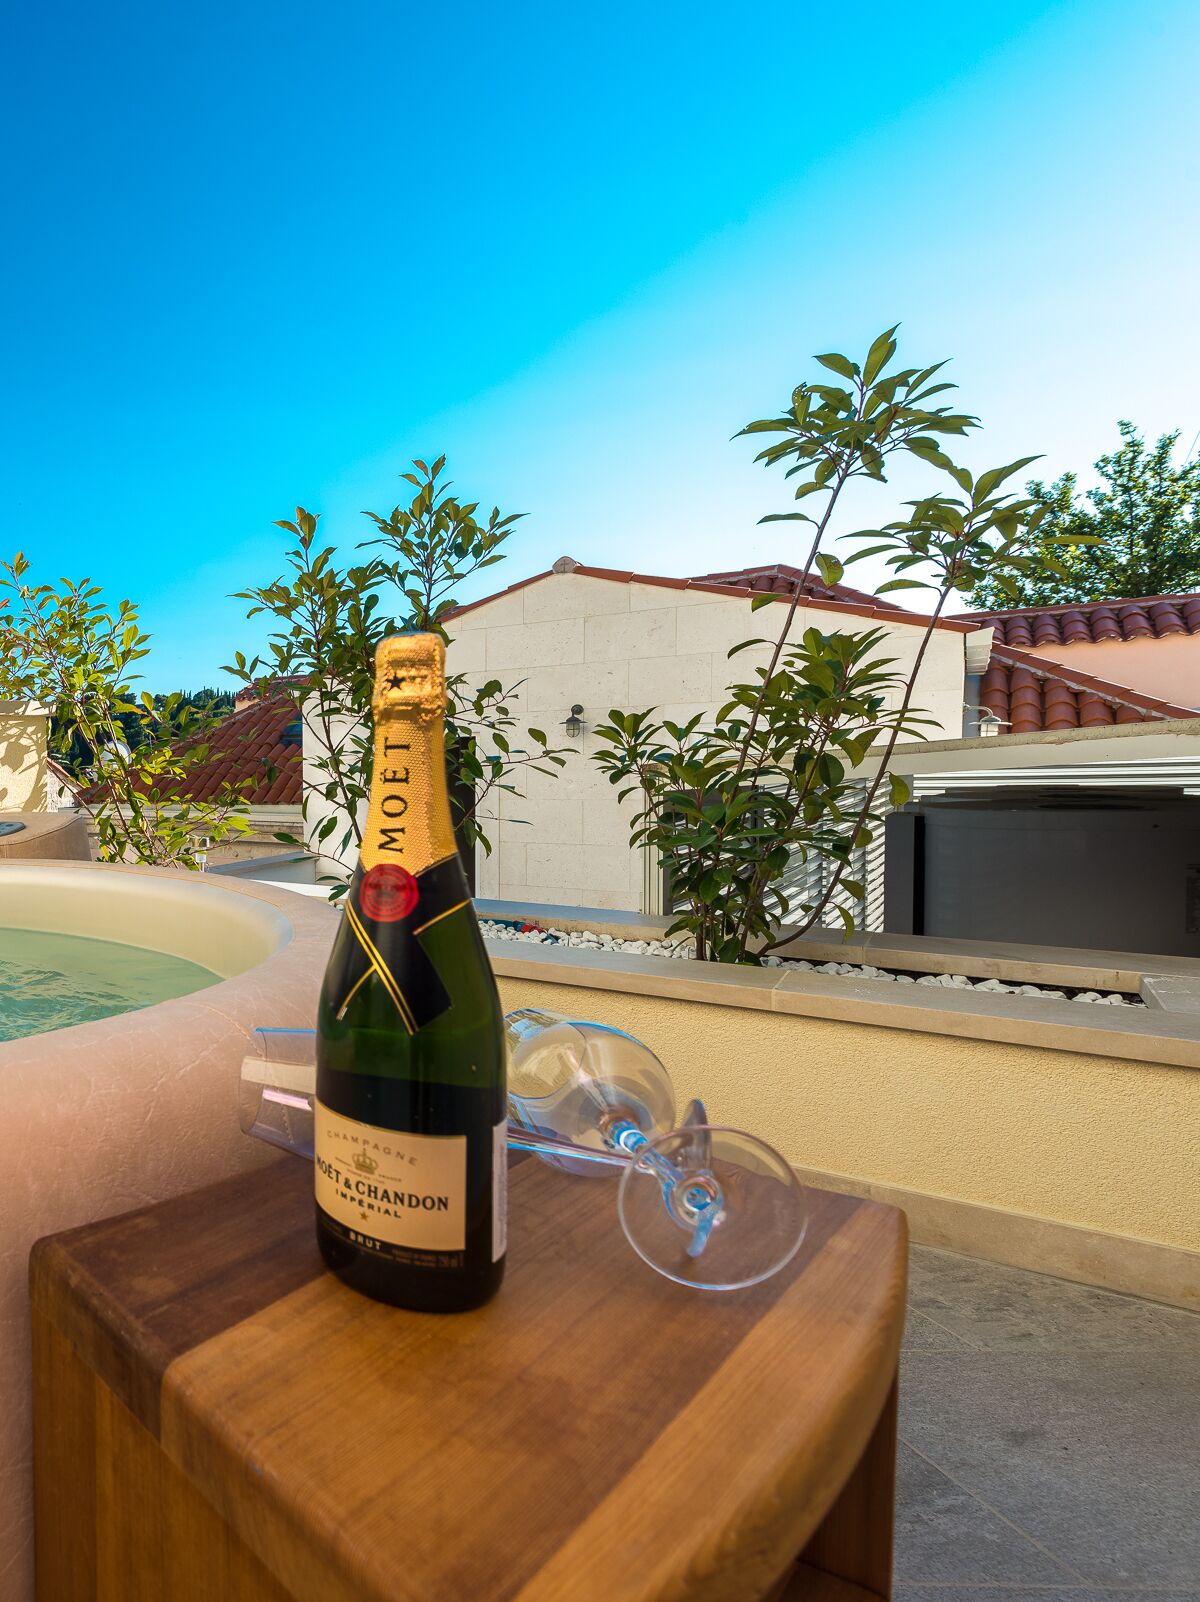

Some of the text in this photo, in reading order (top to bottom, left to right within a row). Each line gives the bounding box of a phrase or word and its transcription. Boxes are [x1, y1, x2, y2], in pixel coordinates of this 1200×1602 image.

[378, 736, 411, 854] MOËT
[327, 1130, 418, 1166] CHAMPAGNE
[335, 1188, 402, 1219] IMPÉRIAL
[343, 1177, 352, 1191] &
[355, 1180, 449, 1211] CHANDON
[349, 1230, 382, 1251] BRUT
